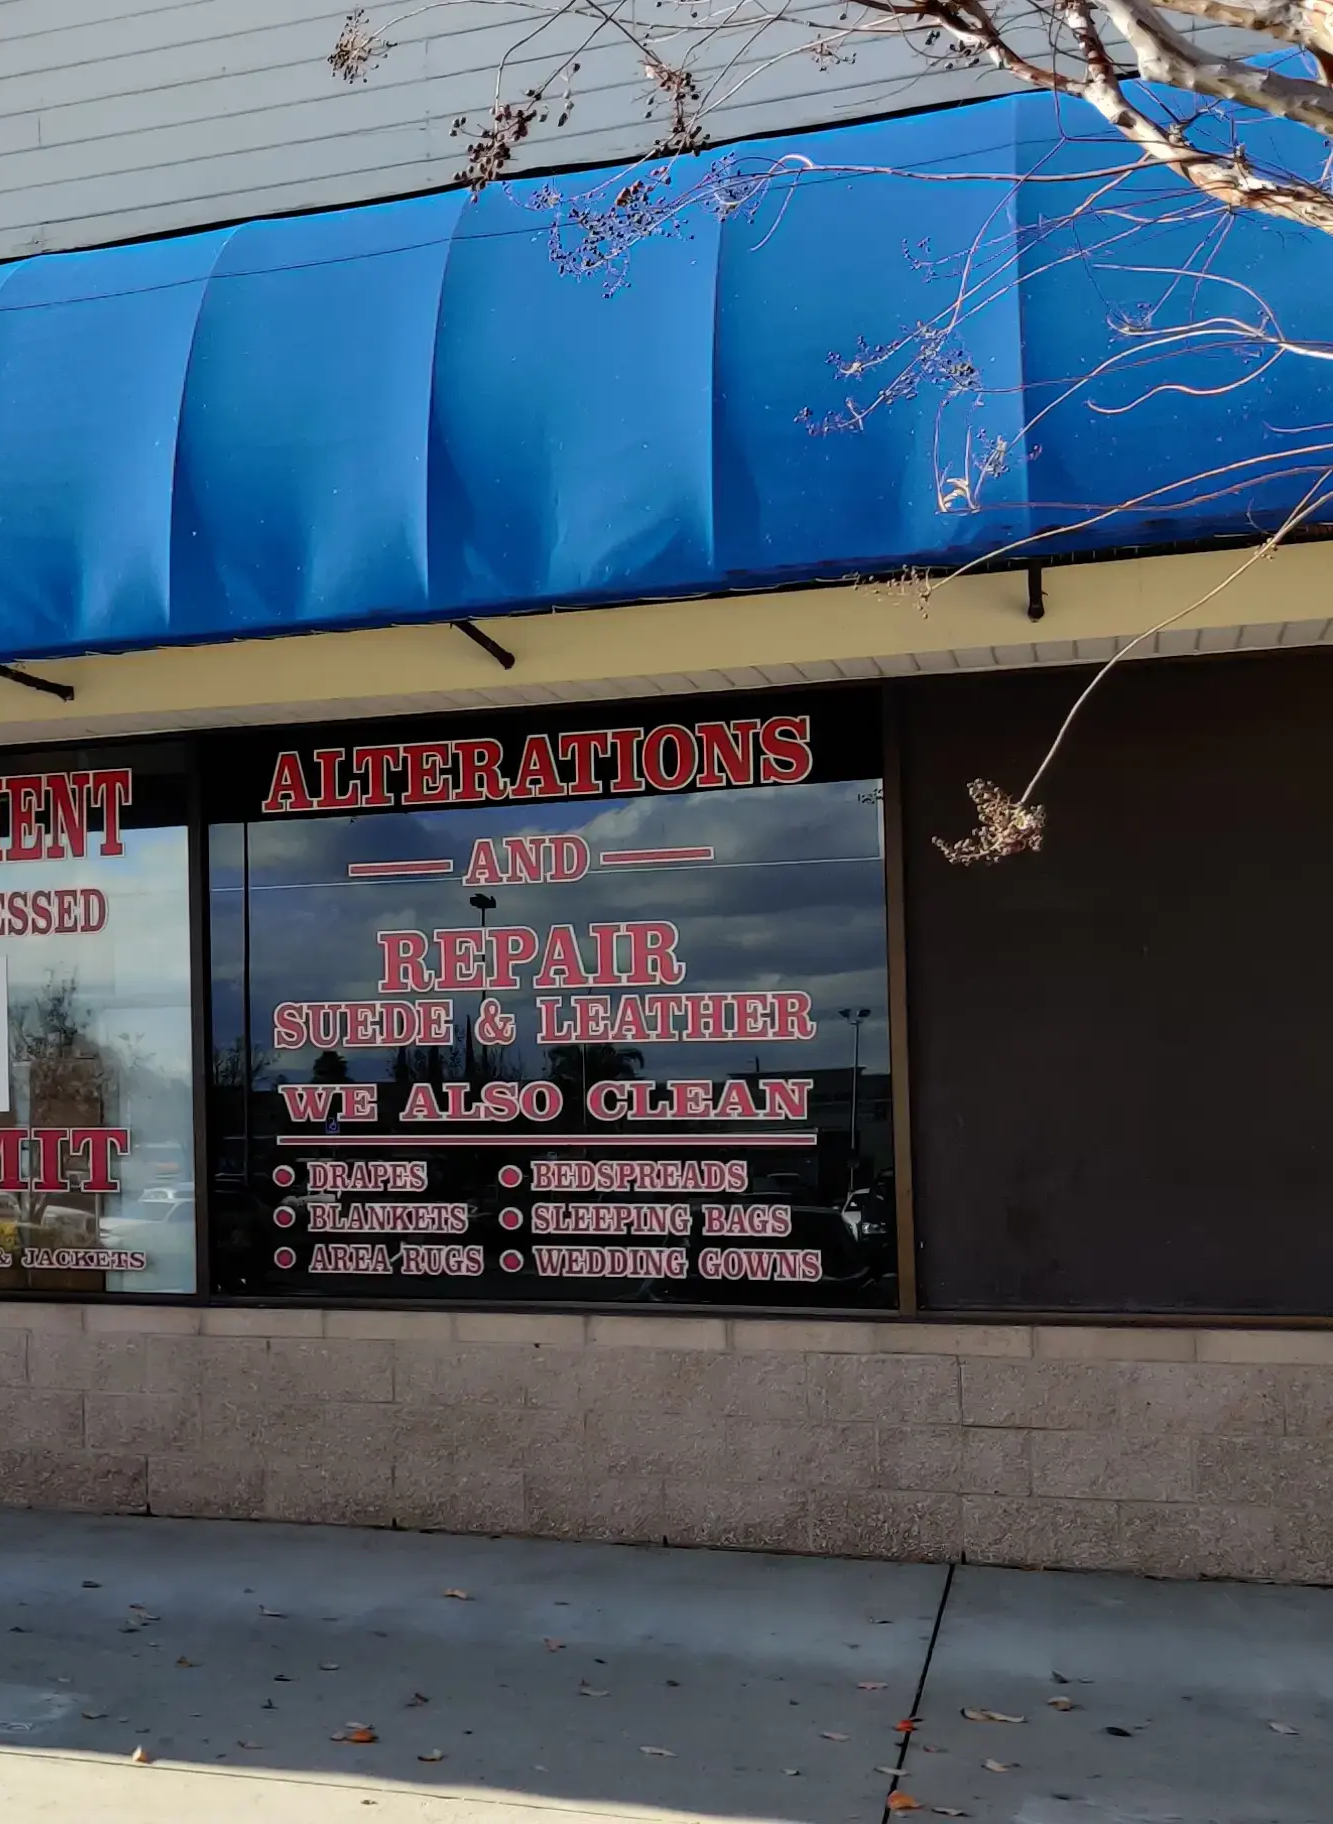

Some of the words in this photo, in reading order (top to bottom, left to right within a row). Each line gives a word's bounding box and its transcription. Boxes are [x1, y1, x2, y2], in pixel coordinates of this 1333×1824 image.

[262, 717, 813, 813] ALTERATIONS
[463, 834, 591, 887] AND
[378, 920, 686, 993] REPAIR
[274, 999, 454, 1050] SUEDE
[475, 998, 516, 1046] &
[537, 991, 817, 1044] LEATHER
[278, 1084, 378, 1122] WE
[400, 1080, 563, 1122] ALSO
[586, 1079, 814, 1121] CLEAN
[307, 1161, 428, 1192] DRAPES
[531, 1160, 748, 1192] BEDSPREADS
[308, 1202, 469, 1234] BLANKETS
[532, 1204, 692, 1236] SLEEPING
[702, 1204, 792, 1237] BAGS
[22, 1247, 147, 1270] JACKETS
[308, 1244, 392, 1275] AREA
[401, 1244, 485, 1276] RUGS
[534, 1246, 688, 1279] WEDDING
[698, 1248, 823, 1283] GOWNS
